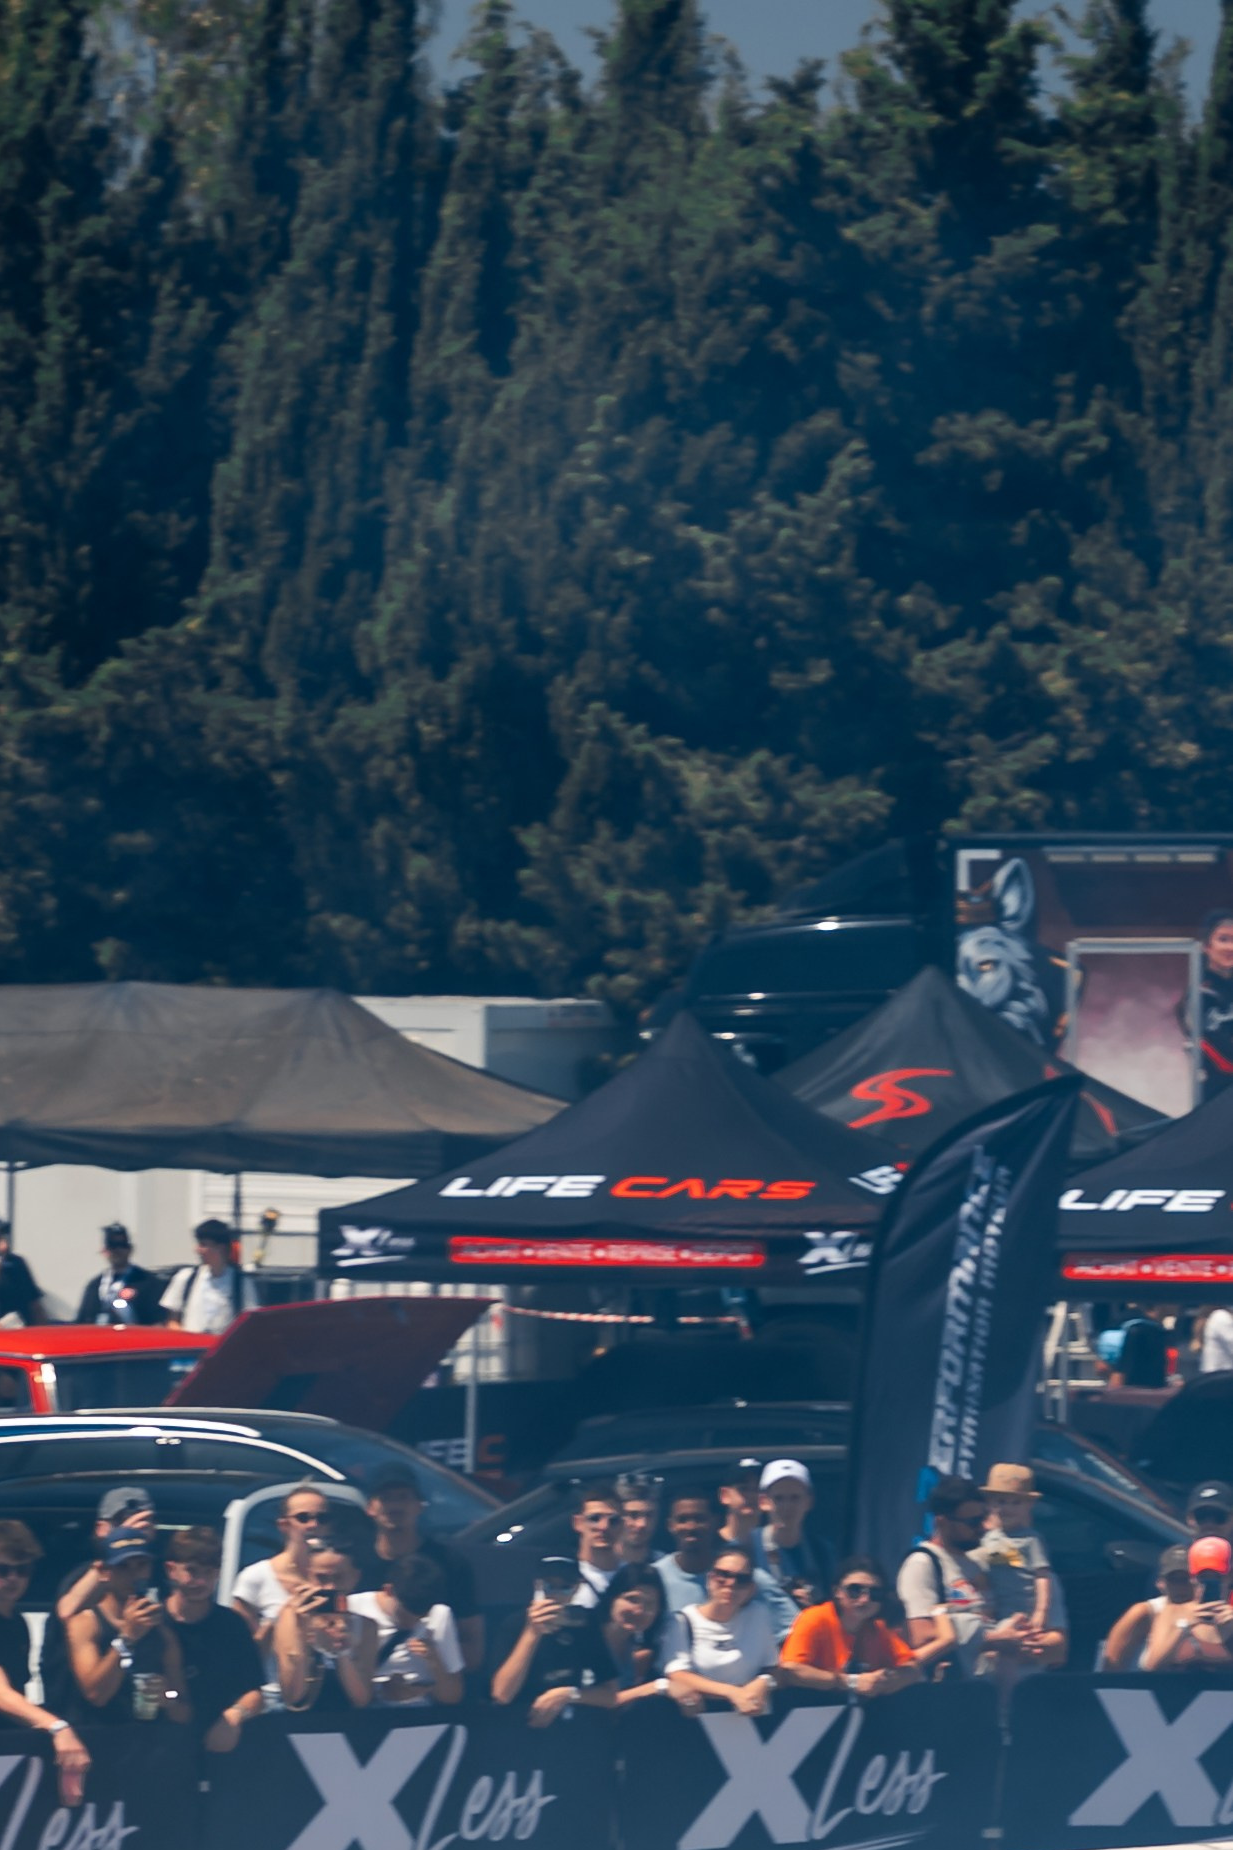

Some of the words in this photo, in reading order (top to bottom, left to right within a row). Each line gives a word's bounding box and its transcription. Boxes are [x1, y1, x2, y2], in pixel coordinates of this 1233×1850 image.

[438, 1175, 607, 1198] LIFE
[609, 1176, 818, 1200] CARS
[1058, 1188, 1227, 1212] LIFE
